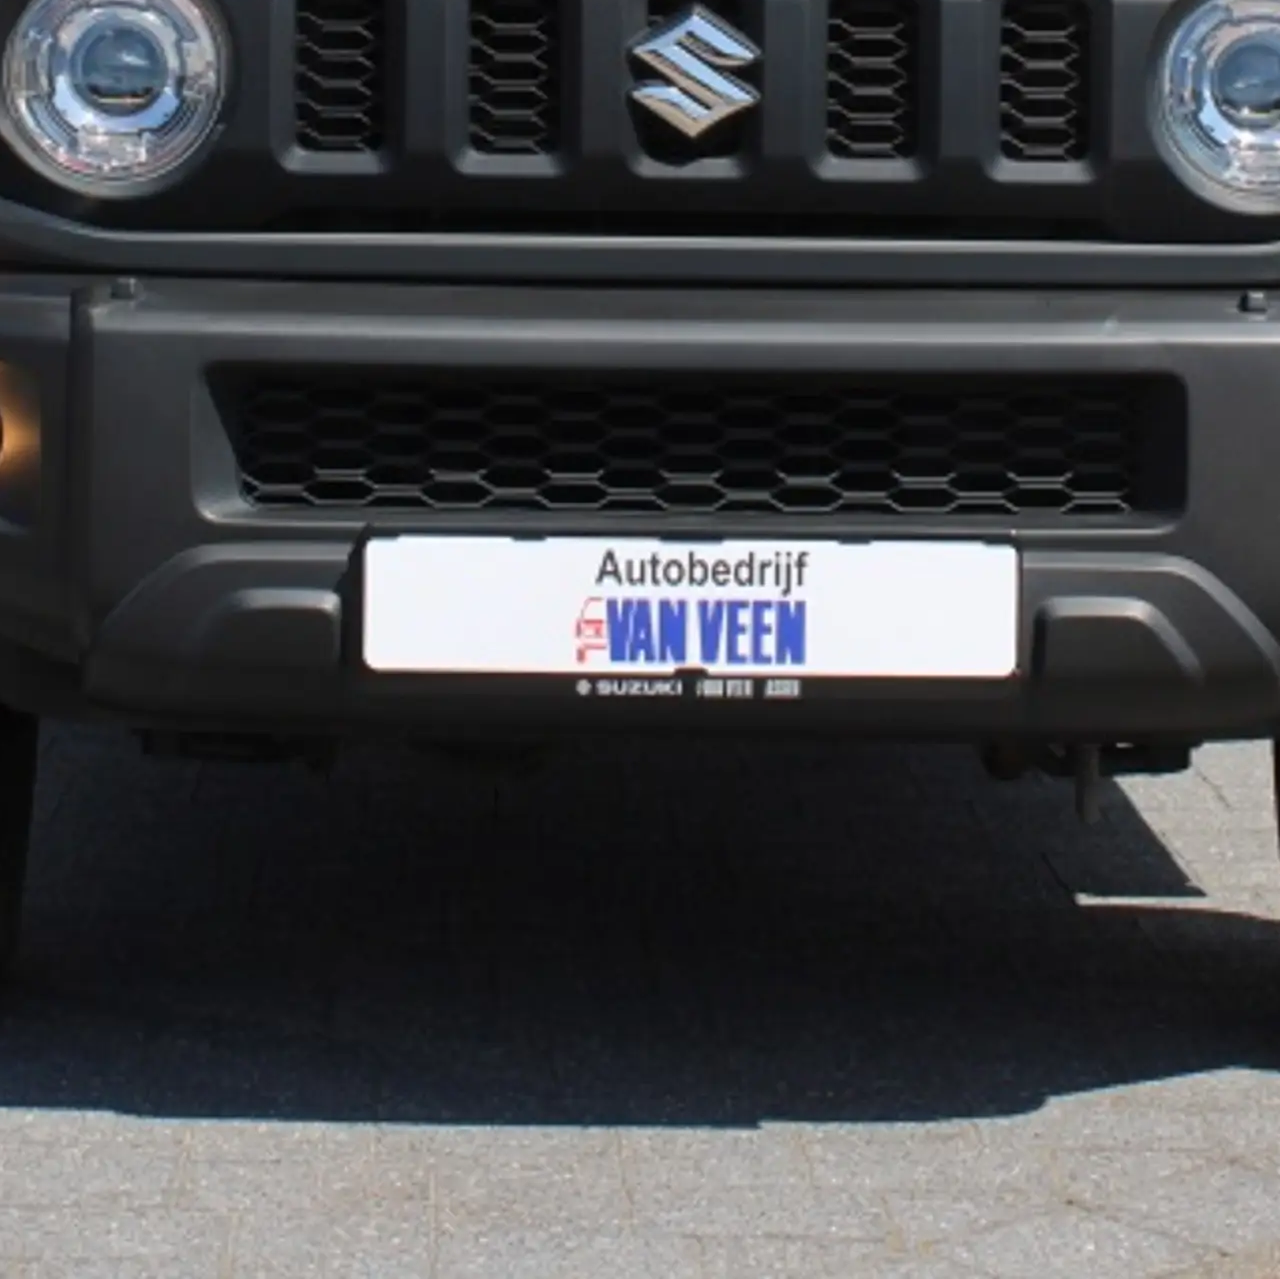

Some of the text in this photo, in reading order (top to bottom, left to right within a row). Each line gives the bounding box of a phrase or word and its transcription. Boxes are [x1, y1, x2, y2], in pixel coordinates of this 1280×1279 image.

[595, 549, 809, 597] Autobedrijf
[606, 599, 807, 665] VAN VEEN
[595, 679, 683, 696] SUZUKI
